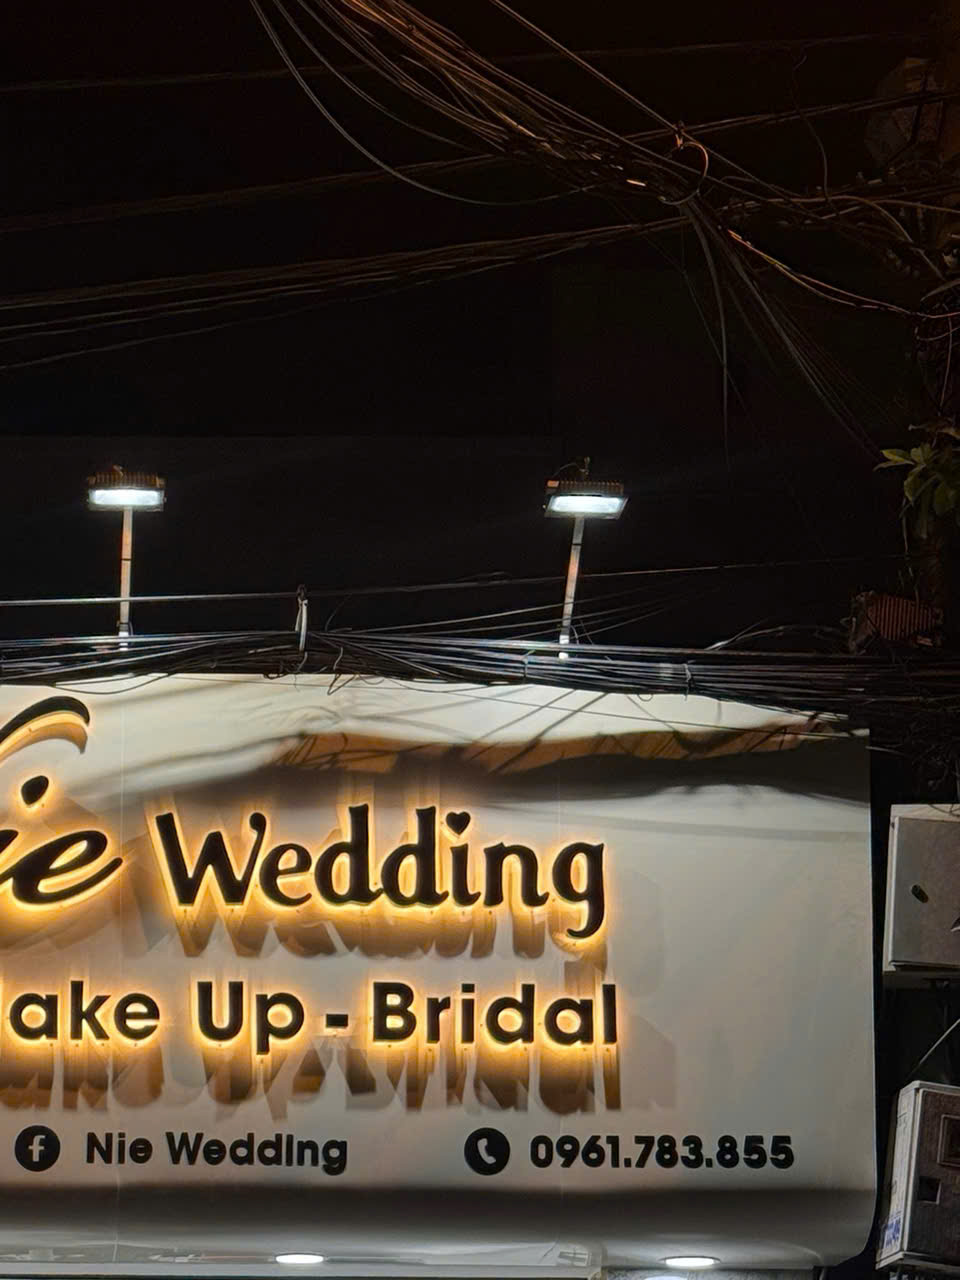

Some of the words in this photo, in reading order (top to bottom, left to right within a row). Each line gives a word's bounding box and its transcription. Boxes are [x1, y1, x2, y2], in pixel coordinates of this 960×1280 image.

[154, 802, 606, 940] Wedding
[196, 981, 306, 1056] Up
[372, 982, 619, 1046] Bridal
[85, 1131, 153, 1165] Nie
[164, 1131, 348, 1176] Wedding
[529, 1134, 795, 1169] 0961.783.855
